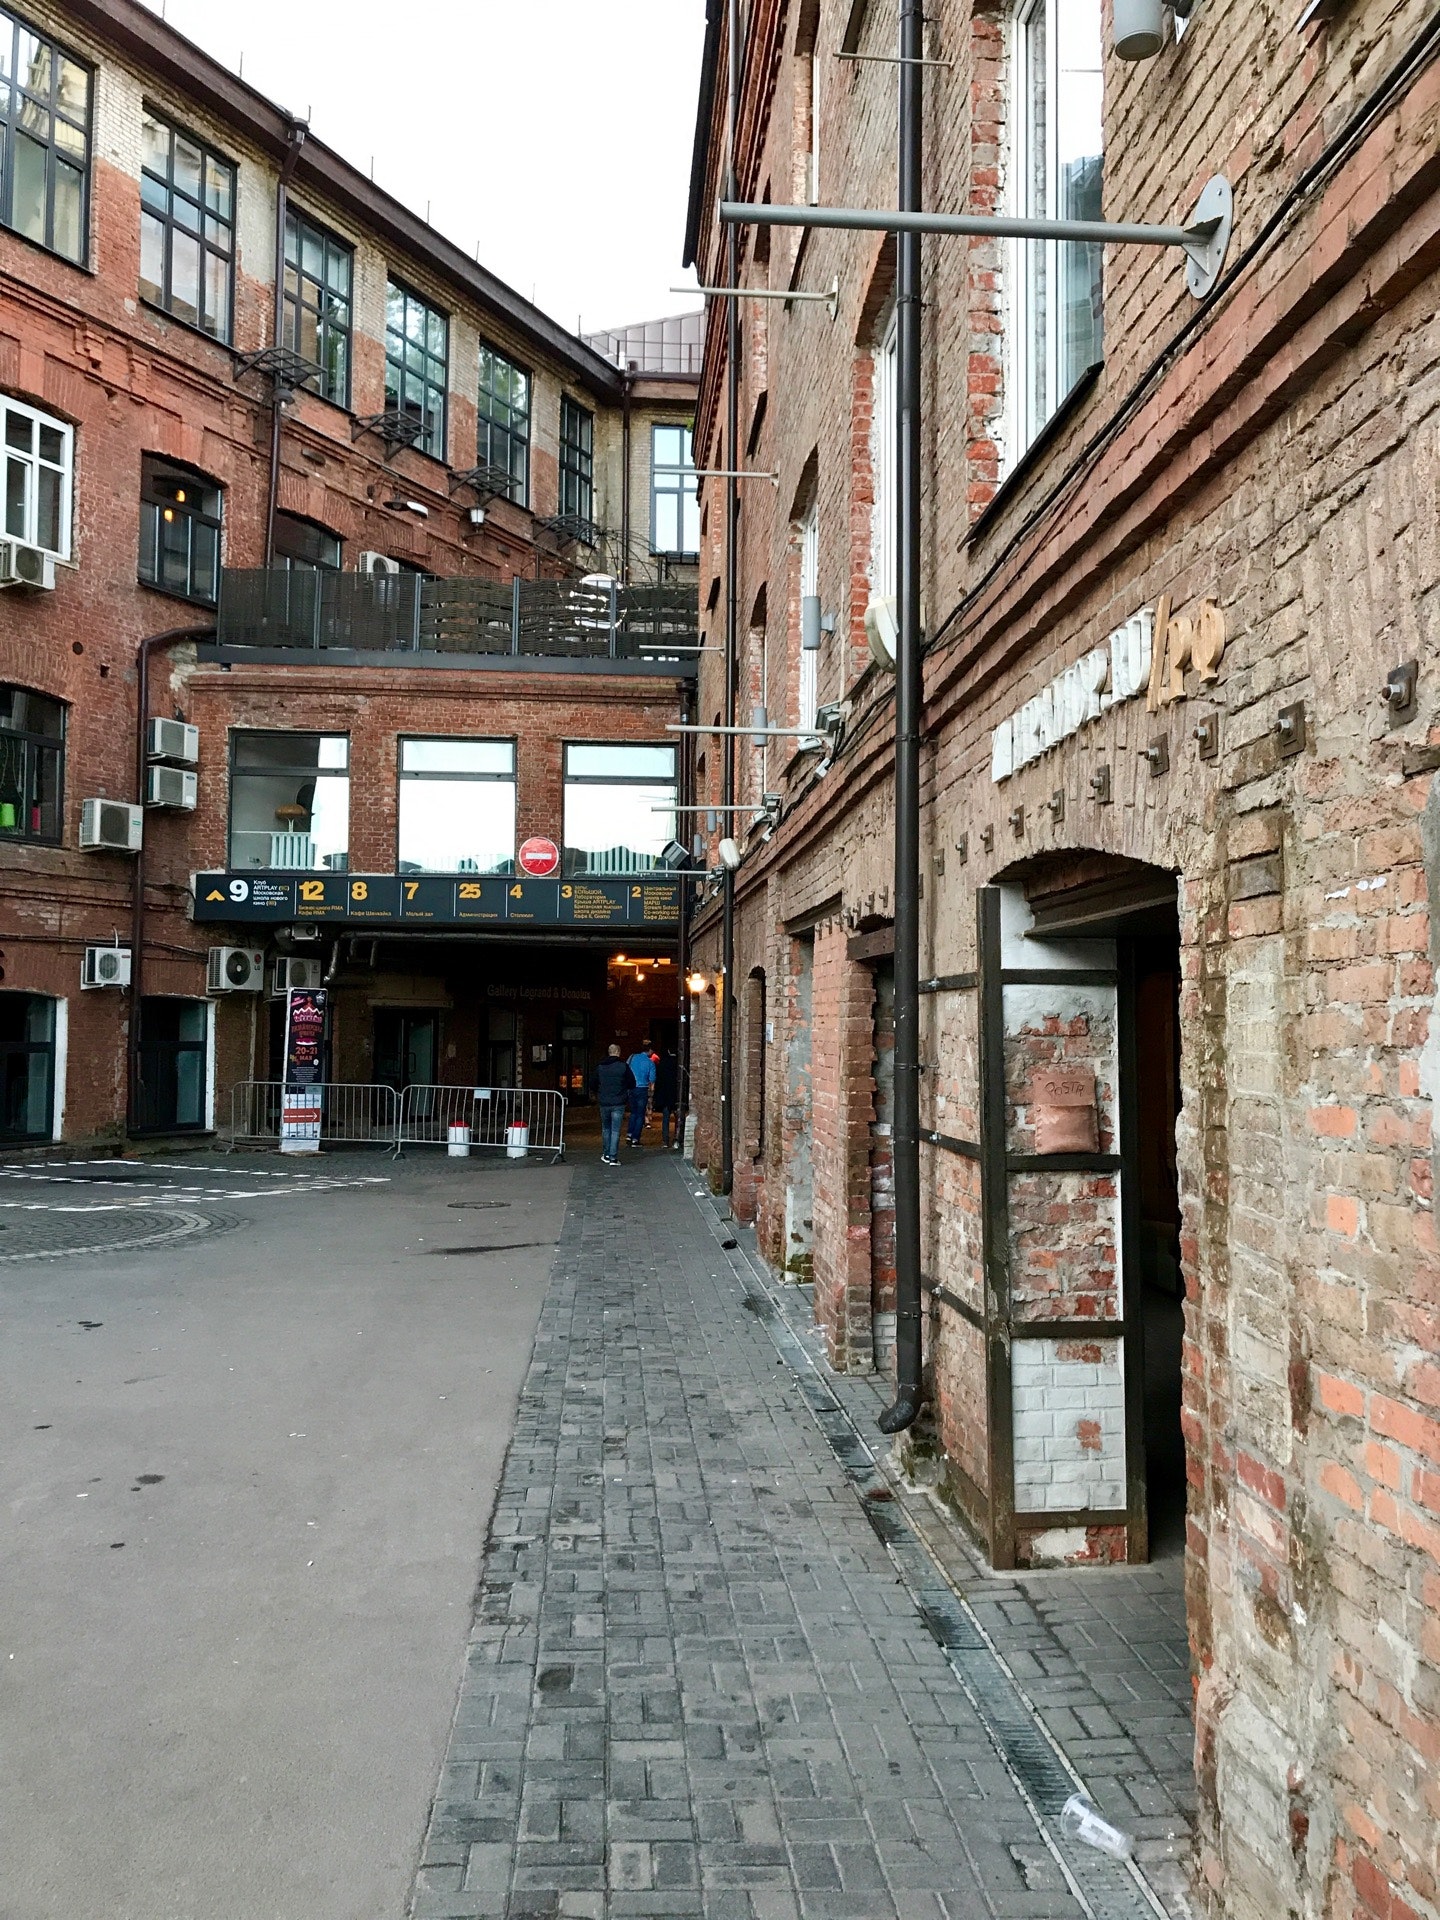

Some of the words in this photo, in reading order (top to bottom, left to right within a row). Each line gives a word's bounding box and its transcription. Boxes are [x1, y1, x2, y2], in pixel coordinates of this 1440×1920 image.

[230, 880, 248, 902] 9
[298, 880, 324, 900] 12
[351, 882, 368, 900] 8
[404, 882, 419, 900] 7
[459, 884, 481, 898] 25
[510, 884, 523, 899] 4
[561, 885, 572, 898] 3
[632, 886, 641, 898] 2
